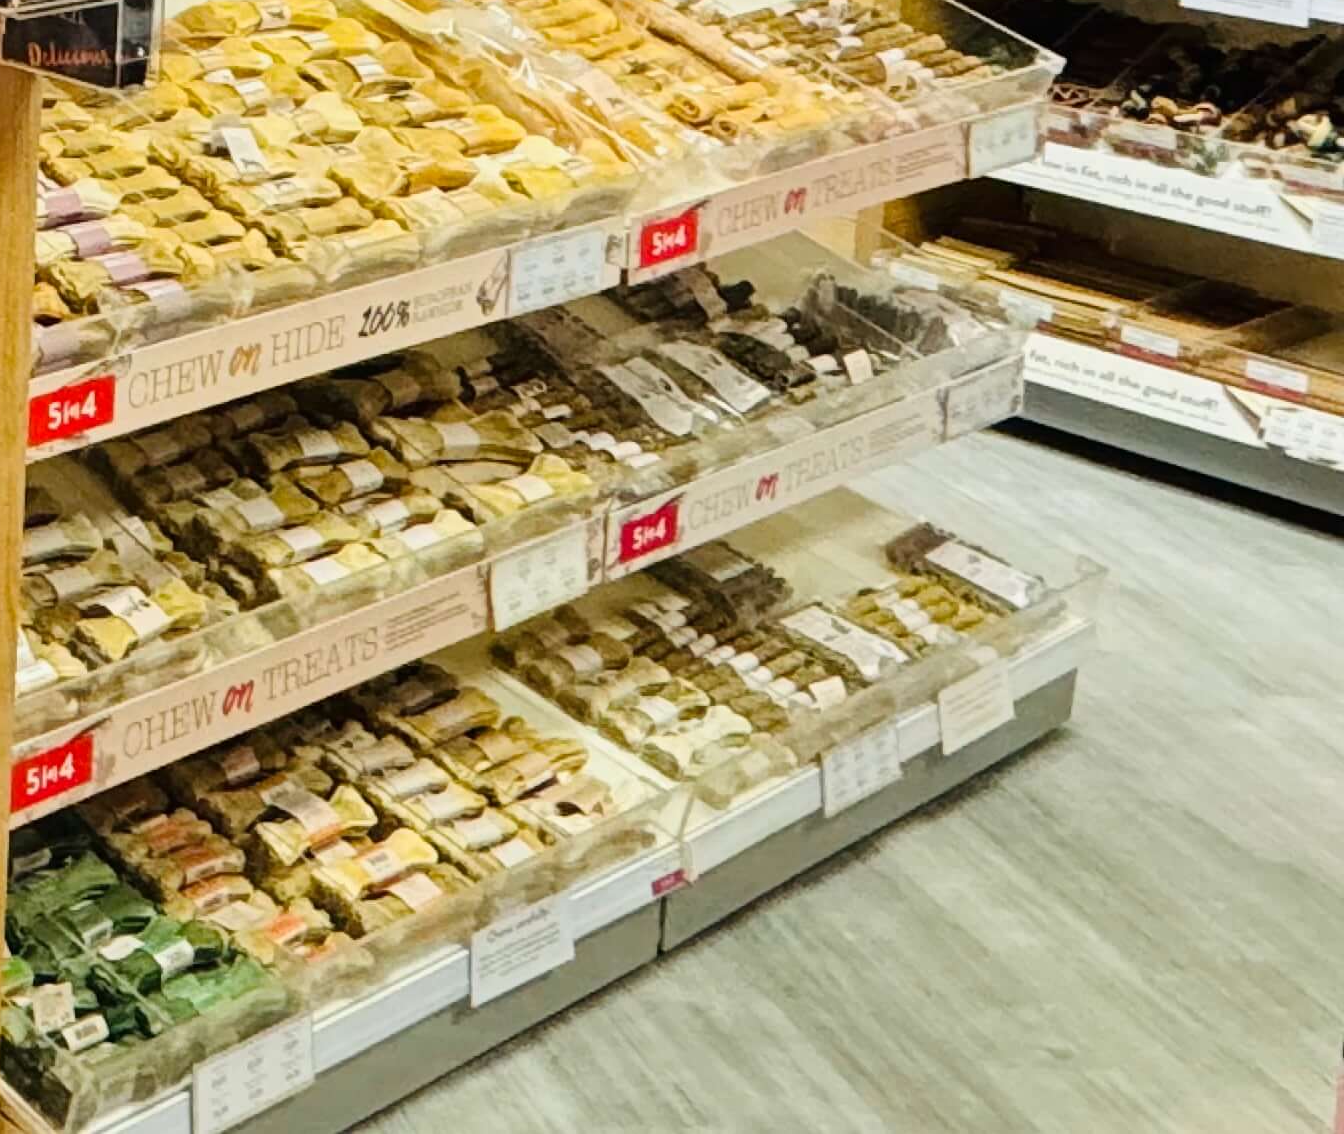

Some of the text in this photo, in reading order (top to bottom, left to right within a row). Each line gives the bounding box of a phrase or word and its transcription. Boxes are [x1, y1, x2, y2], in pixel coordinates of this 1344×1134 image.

[717, 196, 782, 236] CHEW
[127, 300, 410, 408] CHEW on HIDE 100%
[686, 486, 753, 533] CHEW
[122, 690, 219, 759] CHEW
[222, 679, 255, 715] on
[263, 628, 380, 701] TREATS
